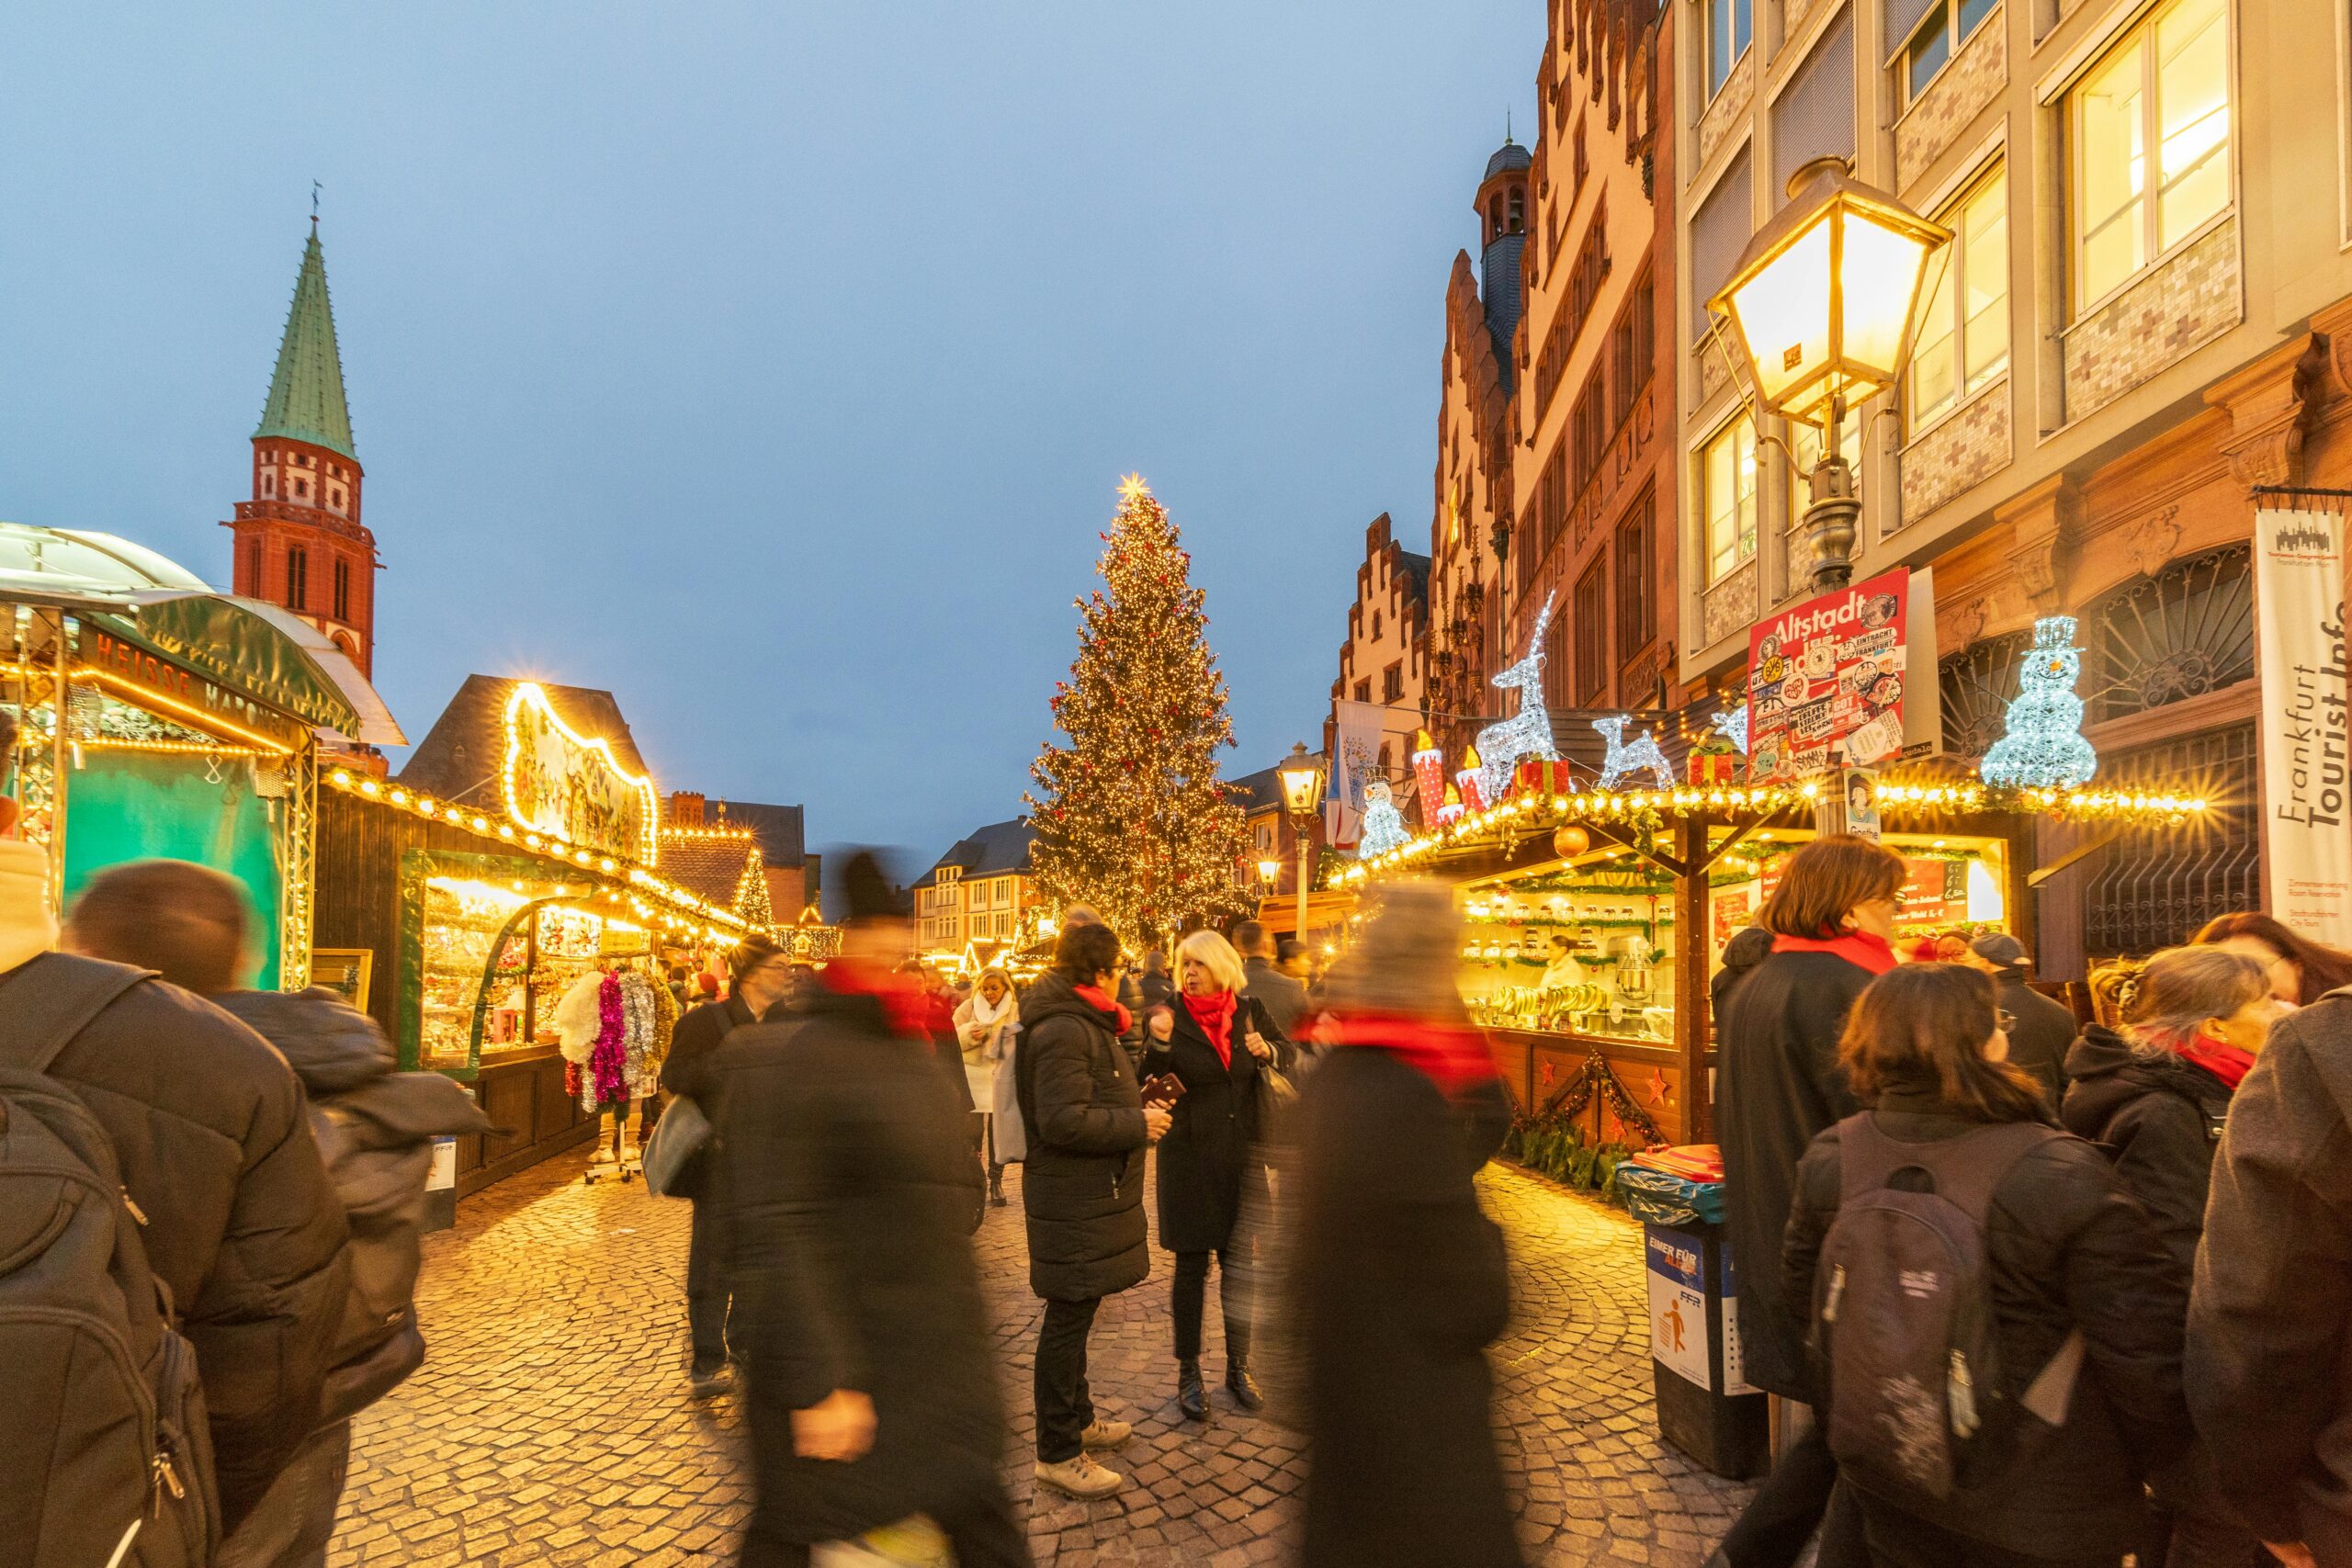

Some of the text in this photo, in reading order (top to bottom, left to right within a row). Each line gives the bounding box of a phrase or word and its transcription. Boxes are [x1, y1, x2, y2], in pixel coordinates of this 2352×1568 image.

[1775, 591, 1866, 644] Altstadt
[1857, 628, 1893, 645] EINTRACHT
[1856, 640, 1894, 657] FRANKFURT
[97, 633, 191, 701] HEISSE
[1765, 659, 1781, 678] BVB
[2278, 664, 2316, 824] Frankfurt
[2308, 693, 2347, 828] Tourist
[1850, 826, 1879, 840] Goethe
[2303, 919, 2319, 927] Tours
[1649, 1236, 1697, 1264] EIMER FÜR
[1679, 1290, 1701, 1308] FFR
